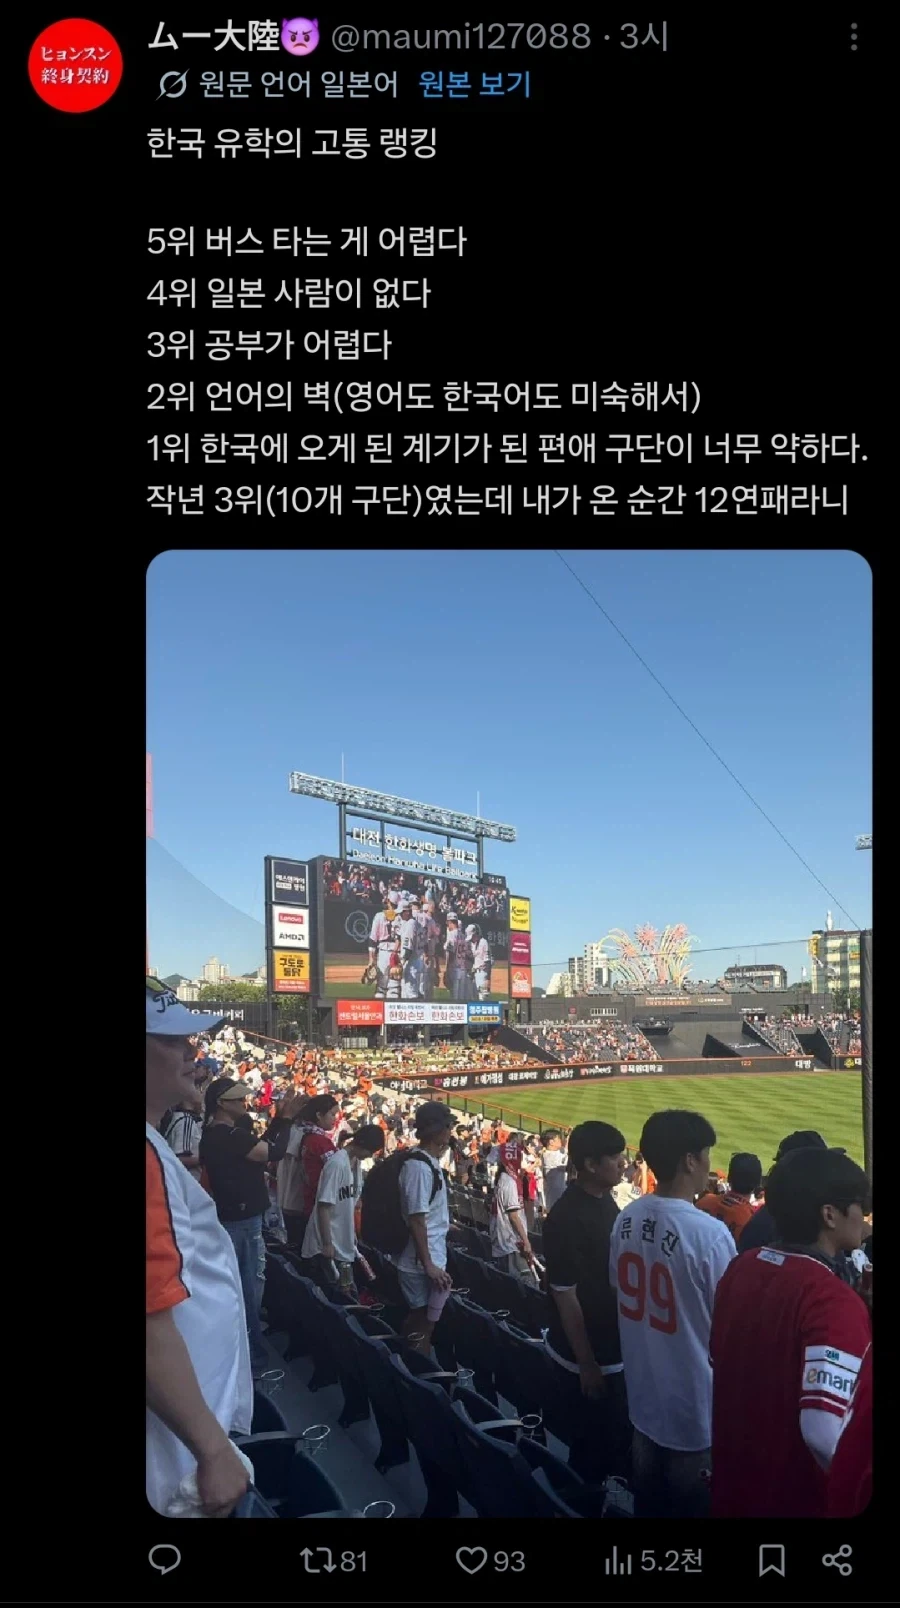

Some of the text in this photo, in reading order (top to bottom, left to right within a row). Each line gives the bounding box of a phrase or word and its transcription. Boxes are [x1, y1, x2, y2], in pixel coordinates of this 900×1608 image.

[352, 827, 477, 865] 대전 한화생명 볼파크
[352, 849, 385, 863] Daejeon
[388, 855, 424, 869] Hanwha
[426, 862, 443, 873] Life
[280, 914, 302, 923] Lenovo
[279, 933, 298, 941] AMD
[389, 1010, 425, 1022] 한화손보
[431, 1010, 465, 1022] 한화손보
[620, 1216, 680, 1258] 류현진
[617, 1252, 677, 1335] 99
